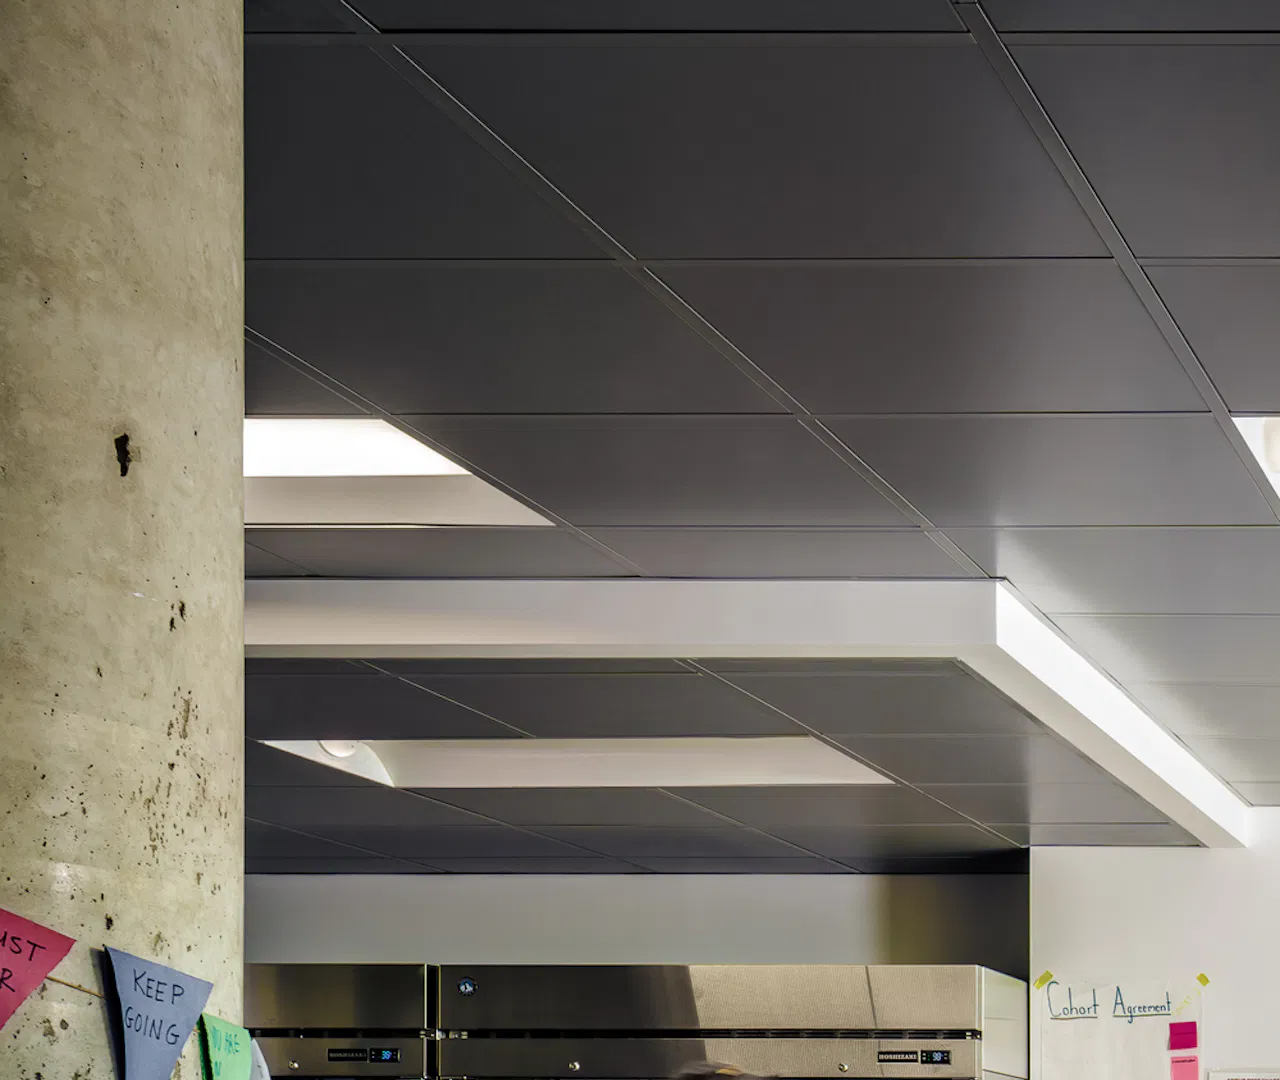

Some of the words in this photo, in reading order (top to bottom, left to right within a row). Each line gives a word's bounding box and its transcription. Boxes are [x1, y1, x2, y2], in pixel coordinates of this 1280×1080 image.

[133, 968, 185, 1005] KEEP
[1047, 981, 1099, 1018] Cohort
[1113, 986, 1171, 1024] Agreement
[125, 1006, 180, 1046] GOING
